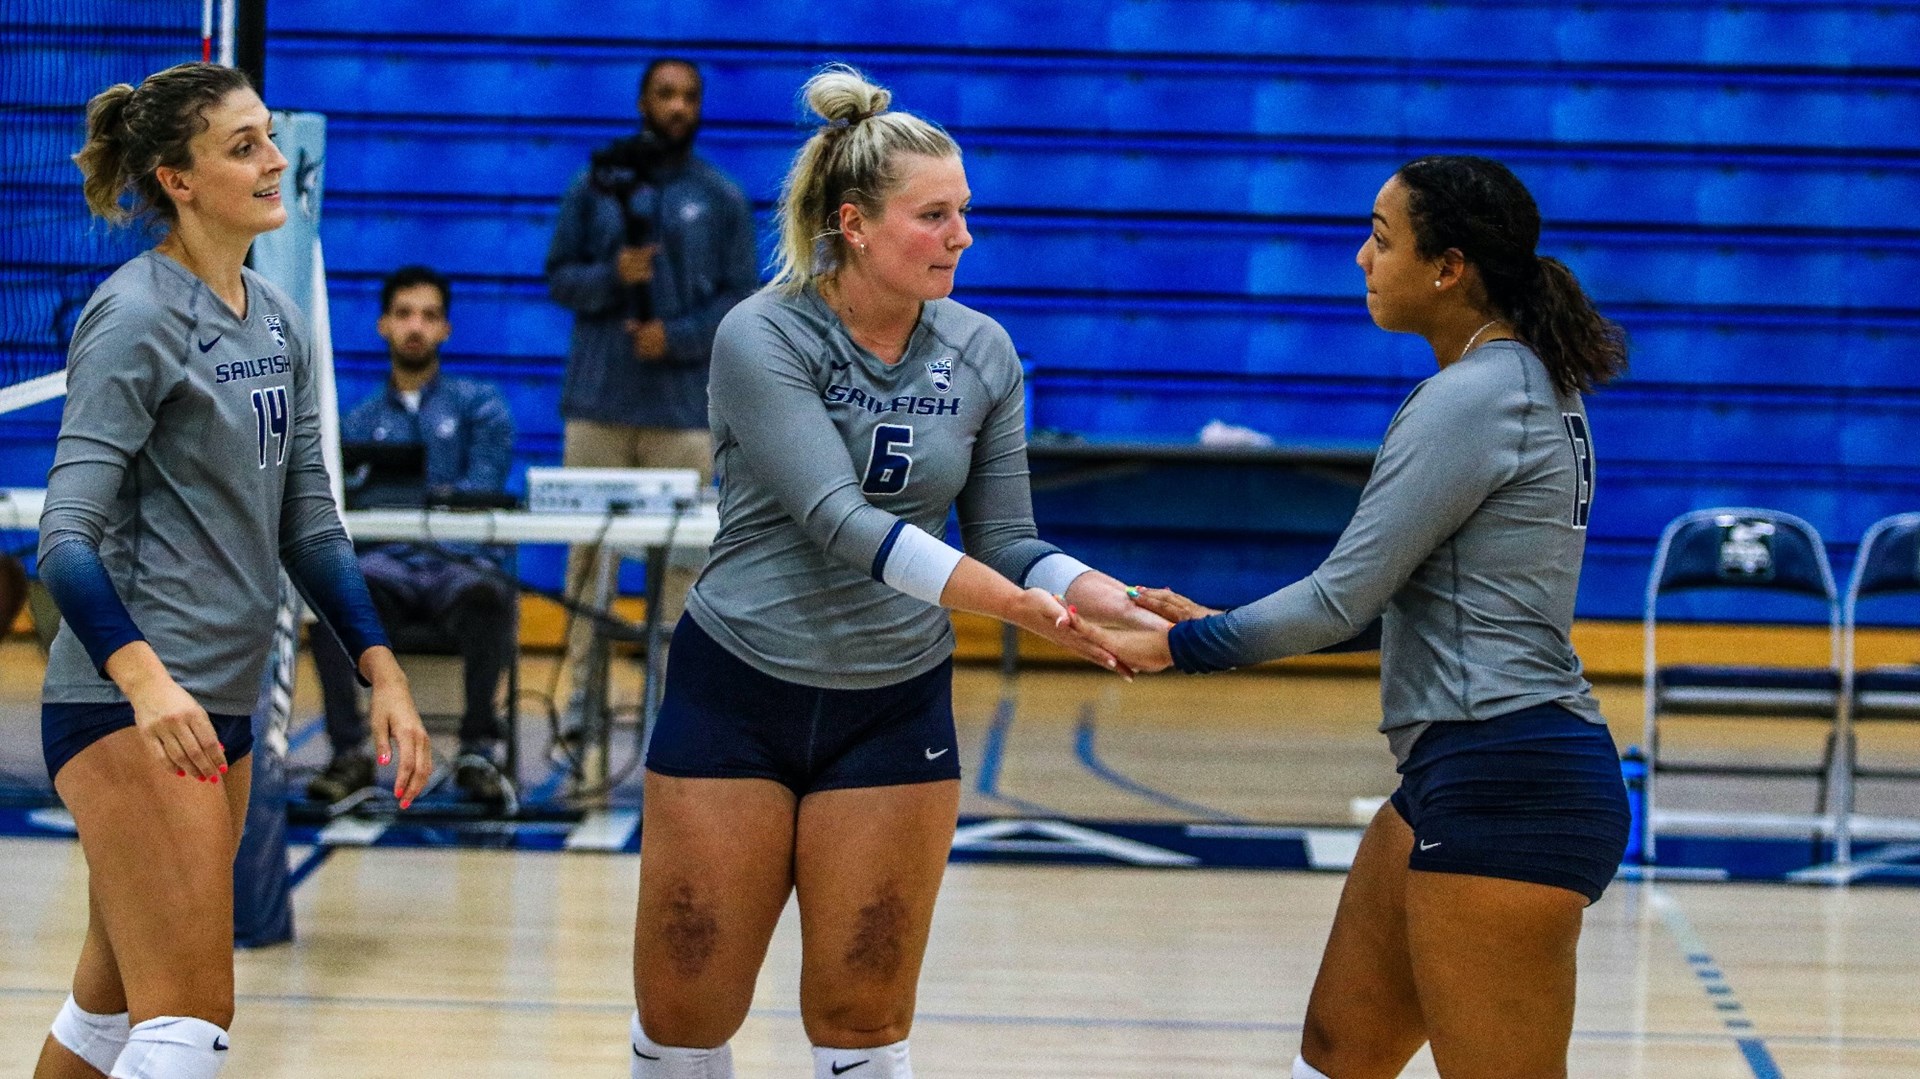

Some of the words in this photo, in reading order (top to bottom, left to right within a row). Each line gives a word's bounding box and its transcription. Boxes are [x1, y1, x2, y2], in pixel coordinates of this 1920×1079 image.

[215, 355, 292, 383] SAILFISH
[929, 360, 951, 369] SSC
[825, 384, 961, 415] SAILFISH
[251, 385, 289, 469] 14
[861, 423, 913, 495] 6
[1562, 412, 1593, 529] 13
